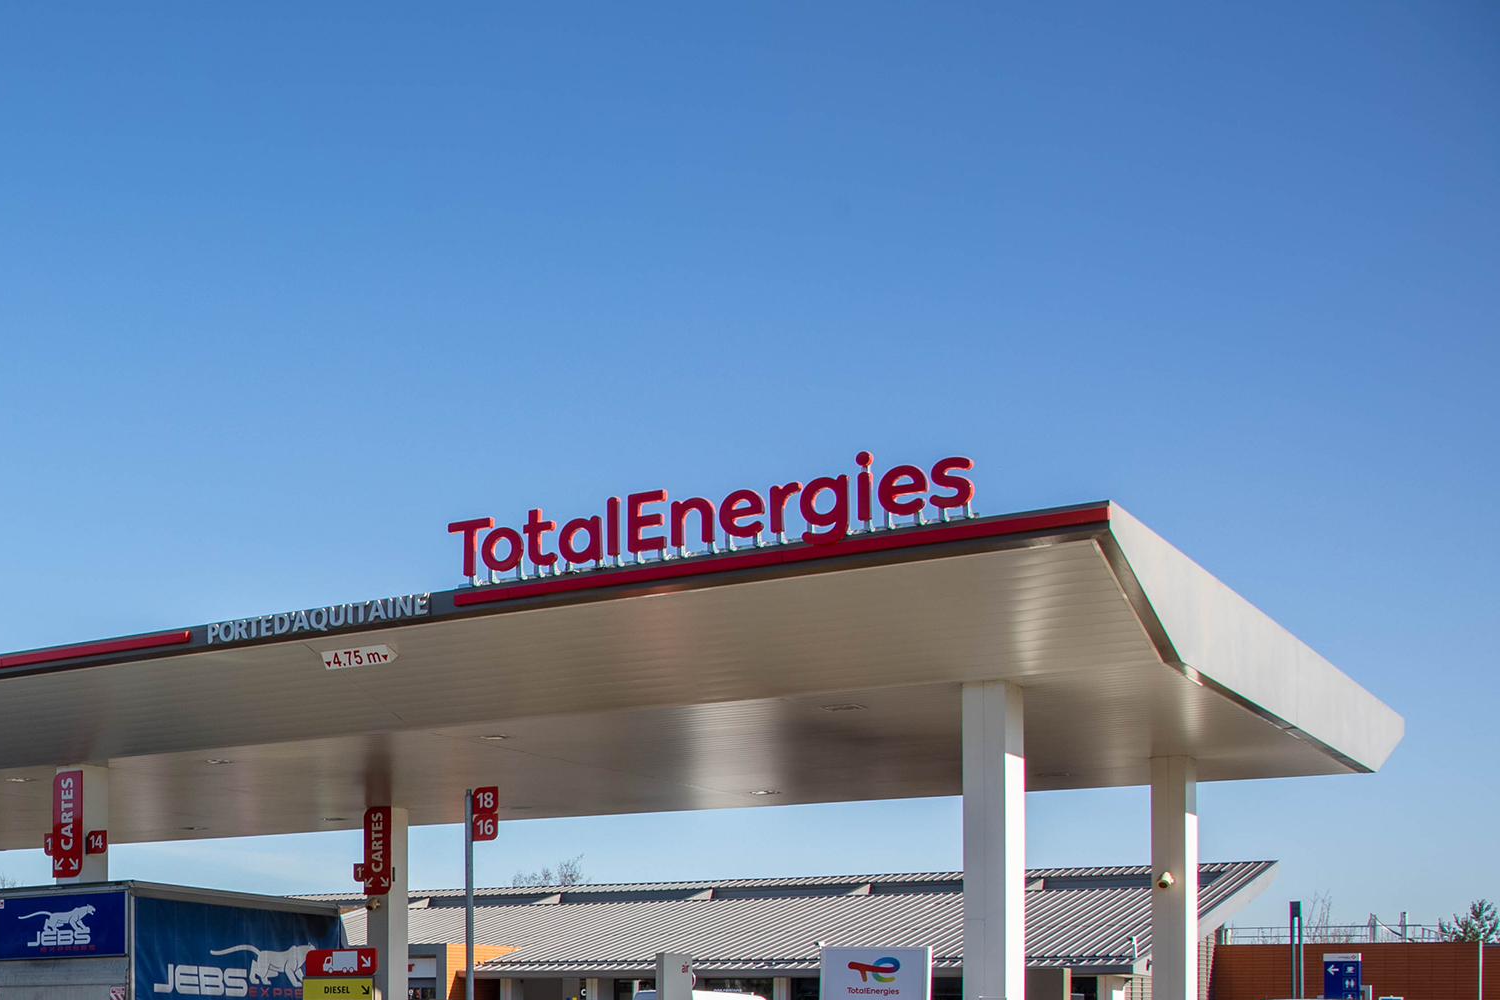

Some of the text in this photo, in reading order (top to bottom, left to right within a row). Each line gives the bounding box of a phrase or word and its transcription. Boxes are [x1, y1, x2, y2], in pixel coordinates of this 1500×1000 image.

[447, 451, 975, 577] TotalEnergies
[332, 650, 382, 667] 4.75 m
[476, 792, 494, 808] 18
[60, 777, 74, 851] CARTES
[476, 819, 494, 835] 16
[89, 834, 103, 849] 14
[371, 812, 383, 873] CARTES
[27, 929, 91, 947] JEBS
[681, 961, 690, 974] air
[153, 963, 248, 998] JEBS
[248, 986, 303, 999] EXPRE
[323, 986, 350, 994] DIESEL
[847, 986, 900, 997] TotalEnergies
